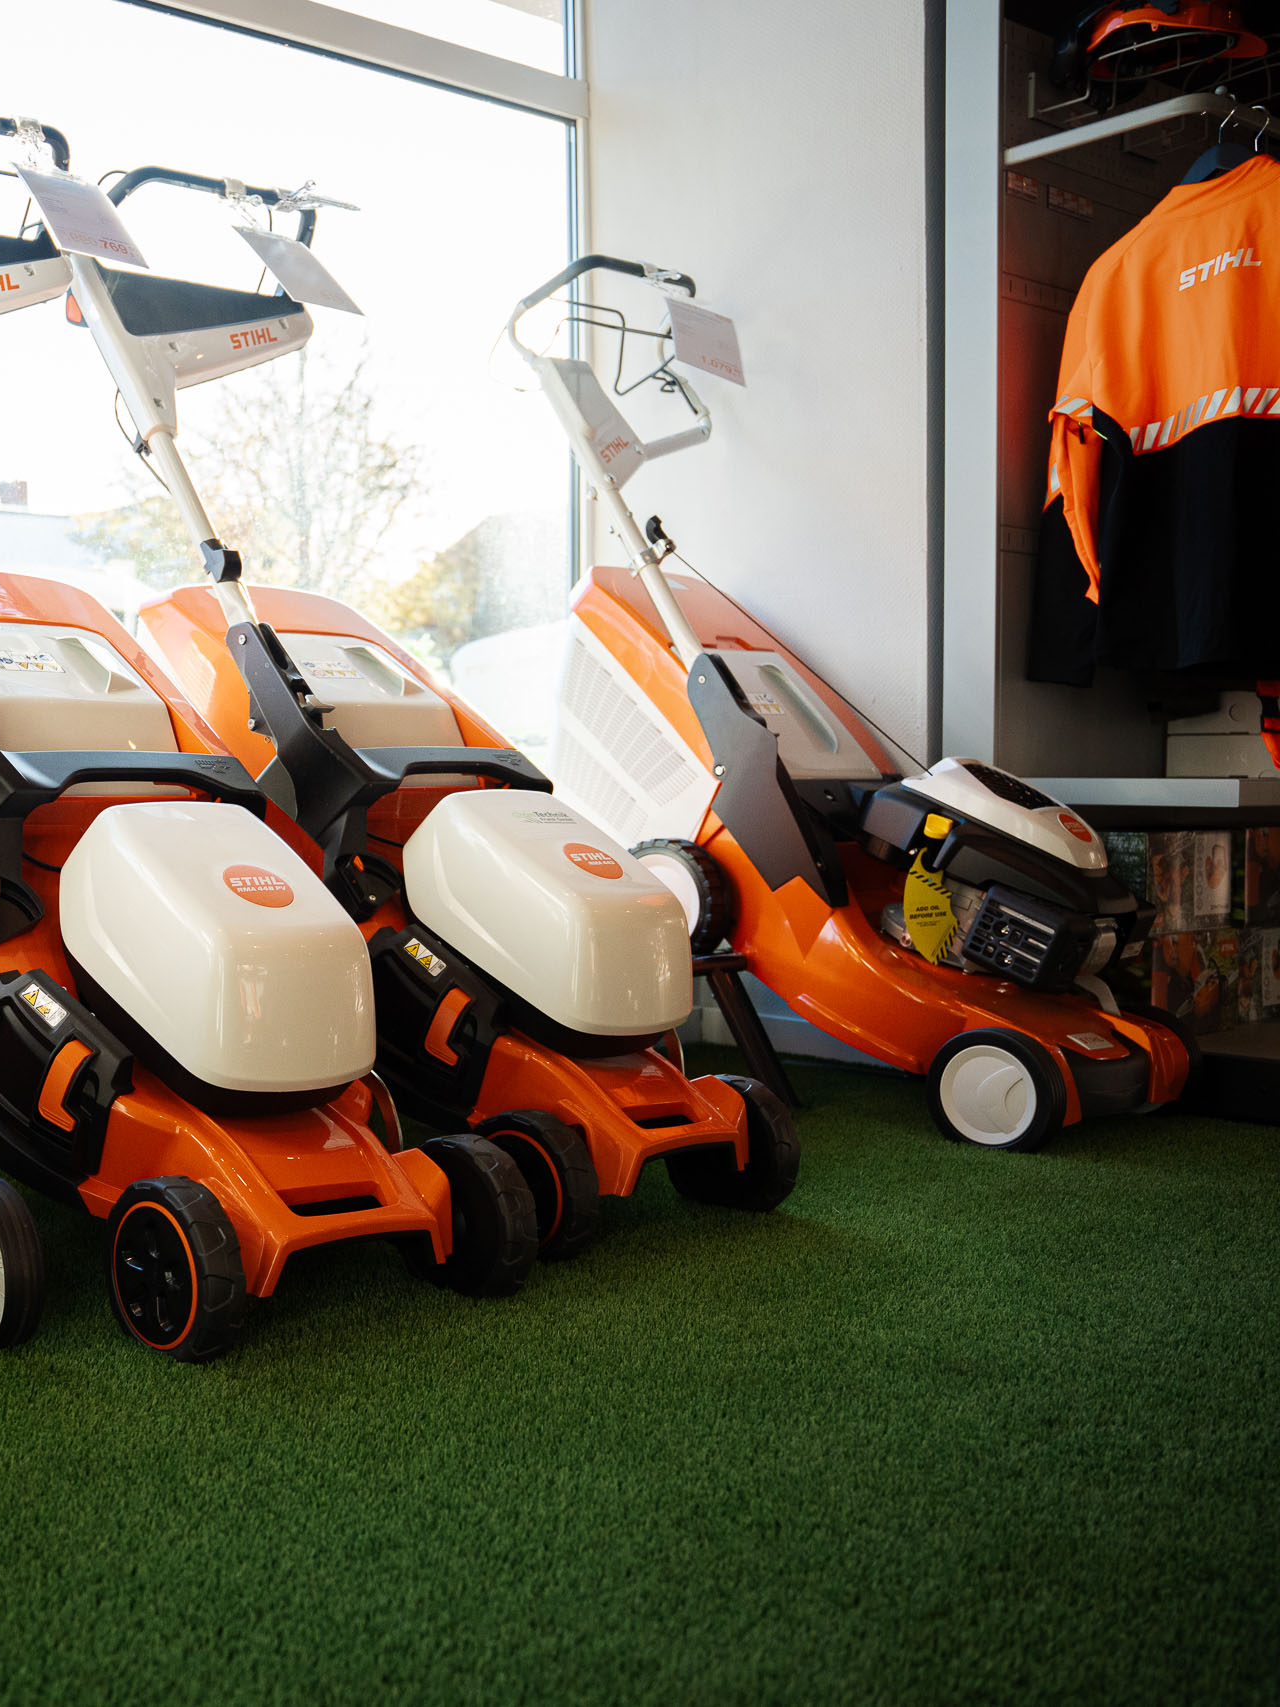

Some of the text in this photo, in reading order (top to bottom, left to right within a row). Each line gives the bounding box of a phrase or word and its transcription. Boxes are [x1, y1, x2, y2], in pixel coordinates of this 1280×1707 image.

[1179, 247, 1262, 292] STIHL
[229, 327, 278, 350] STIHL
[599, 434, 630, 464] STIHL
[569, 852, 612, 862] STIHL
[229, 875, 285, 887] STIHL
